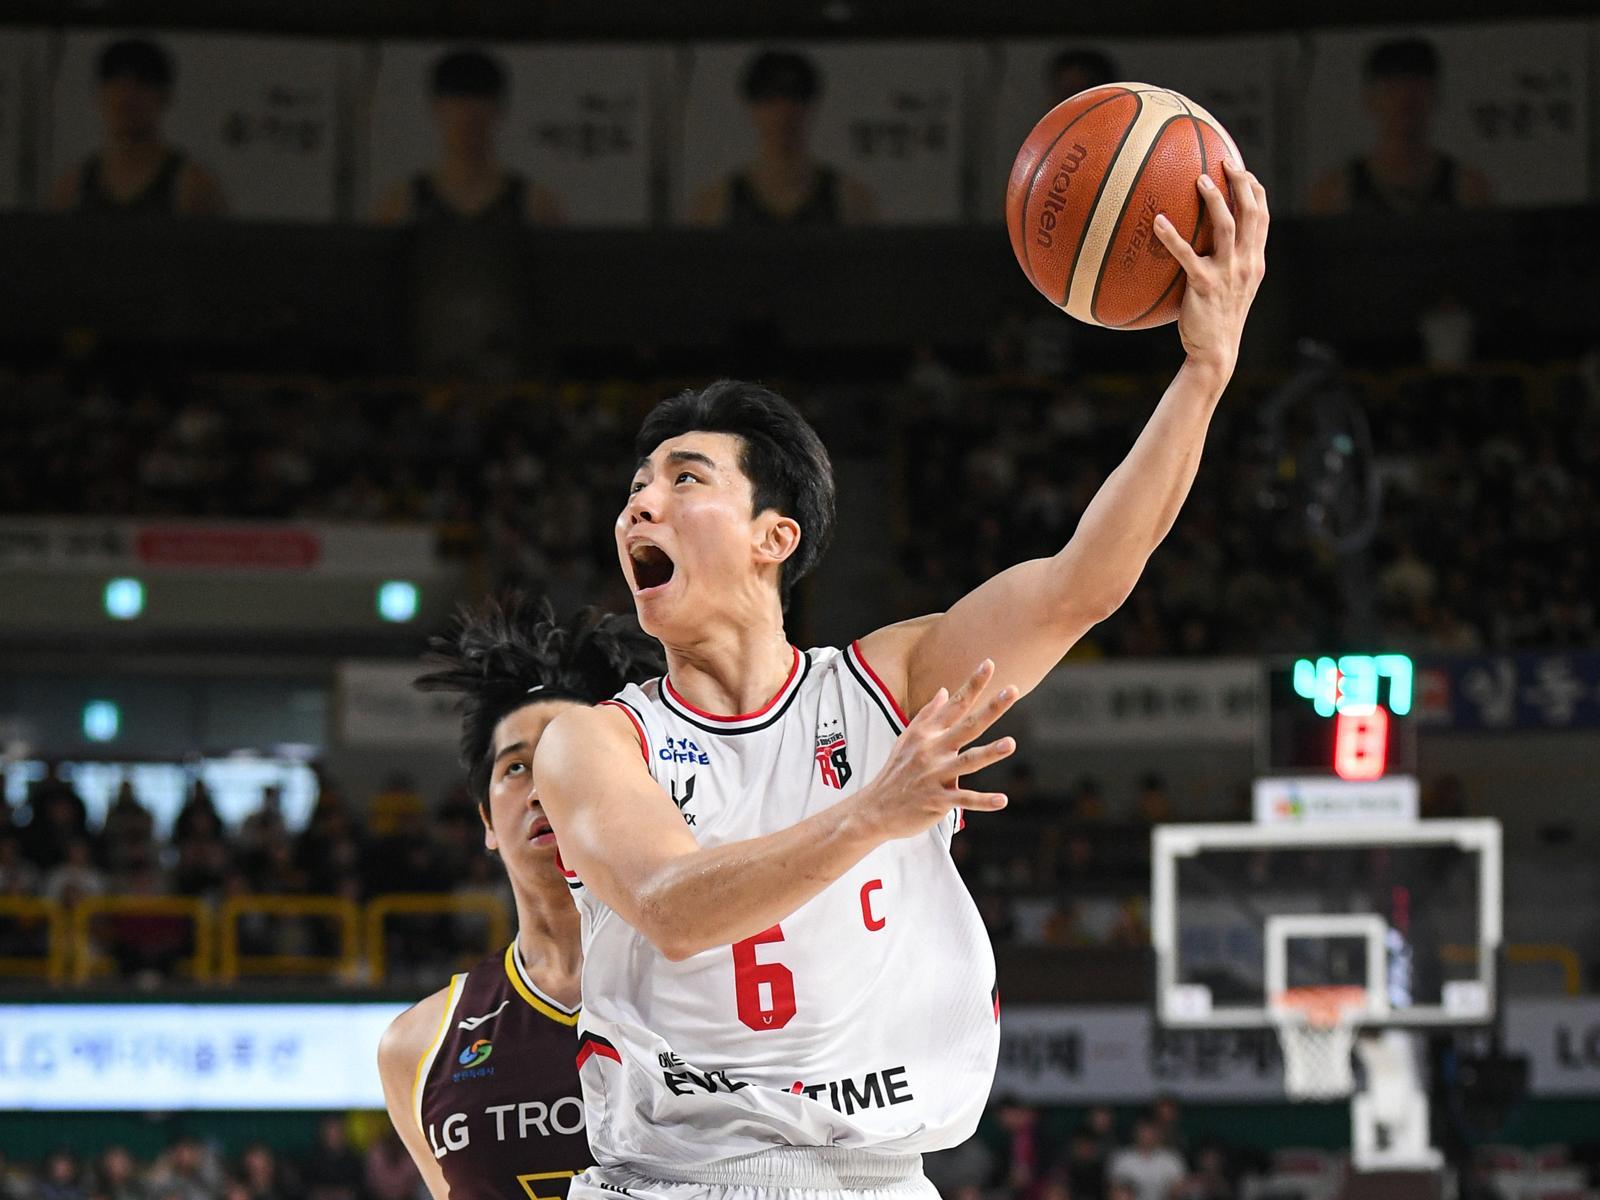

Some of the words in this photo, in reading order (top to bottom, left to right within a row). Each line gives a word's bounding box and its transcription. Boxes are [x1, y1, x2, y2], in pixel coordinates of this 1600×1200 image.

[1036, 143, 1087, 249] molten
[859, 878, 887, 932] C
[732, 922, 798, 1032] 6
[429, 1112, 470, 1159] LG
[484, 1096, 586, 1142] TRO
